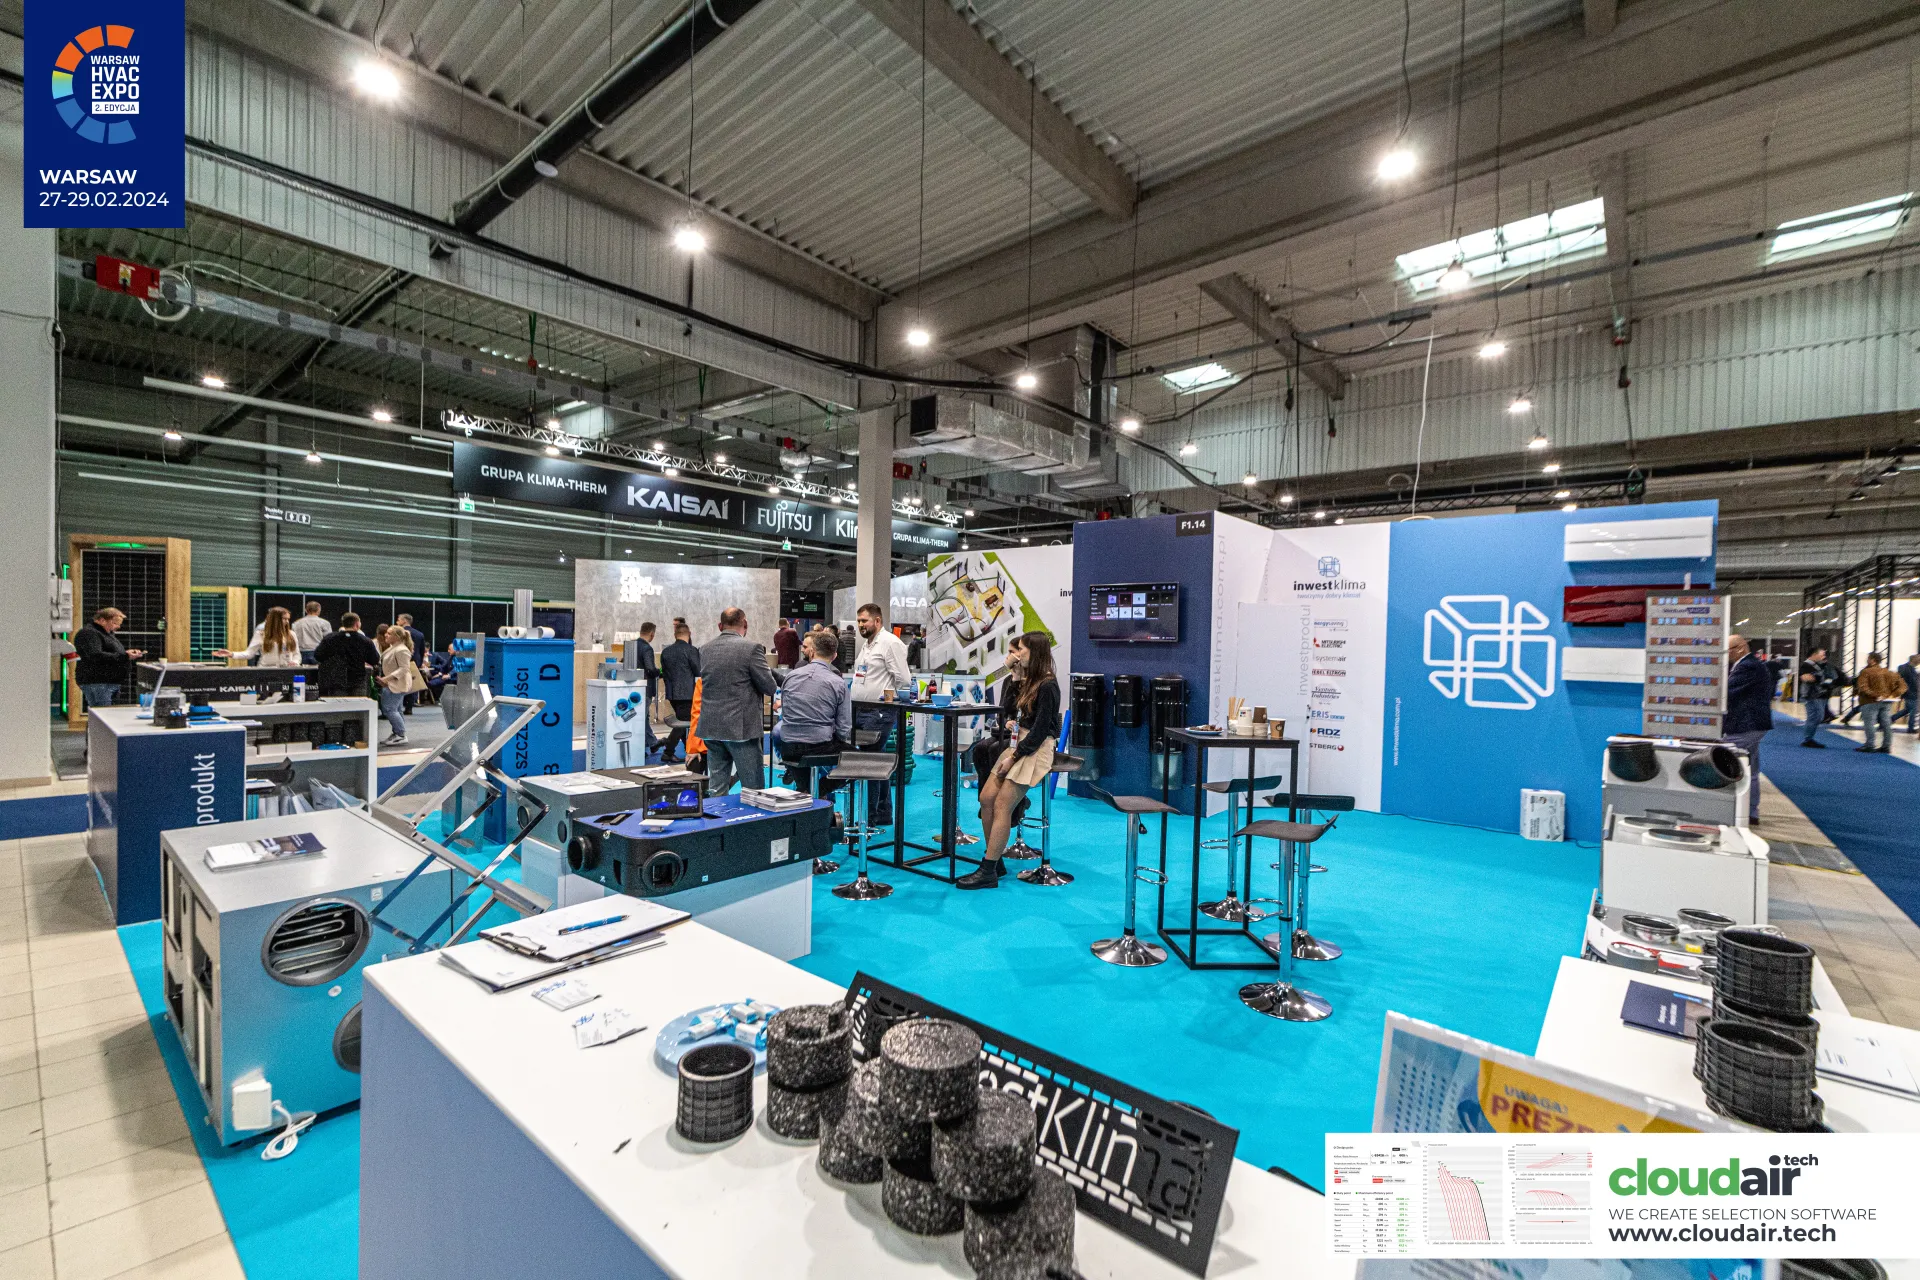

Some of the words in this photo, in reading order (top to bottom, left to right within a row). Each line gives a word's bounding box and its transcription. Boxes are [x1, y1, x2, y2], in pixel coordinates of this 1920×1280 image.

[481, 464, 524, 483] GRUPA
[527, 472, 607, 496] KLIMA-THERM
[627, 485, 730, 520] KAISAI
[757, 500, 813, 534] FUJITSU
[1181, 519, 1206, 530] F1.14
[892, 531, 912, 544] GRUPA
[912, 534, 949, 549] KLIMA-THERM
[1293, 579, 1367, 591] inwestklima
[540, 664, 561, 681] D
[219, 685, 256, 693] KAISAI
[1317, 727, 1341, 736] RDZ
[190, 752, 220, 825] produkt
